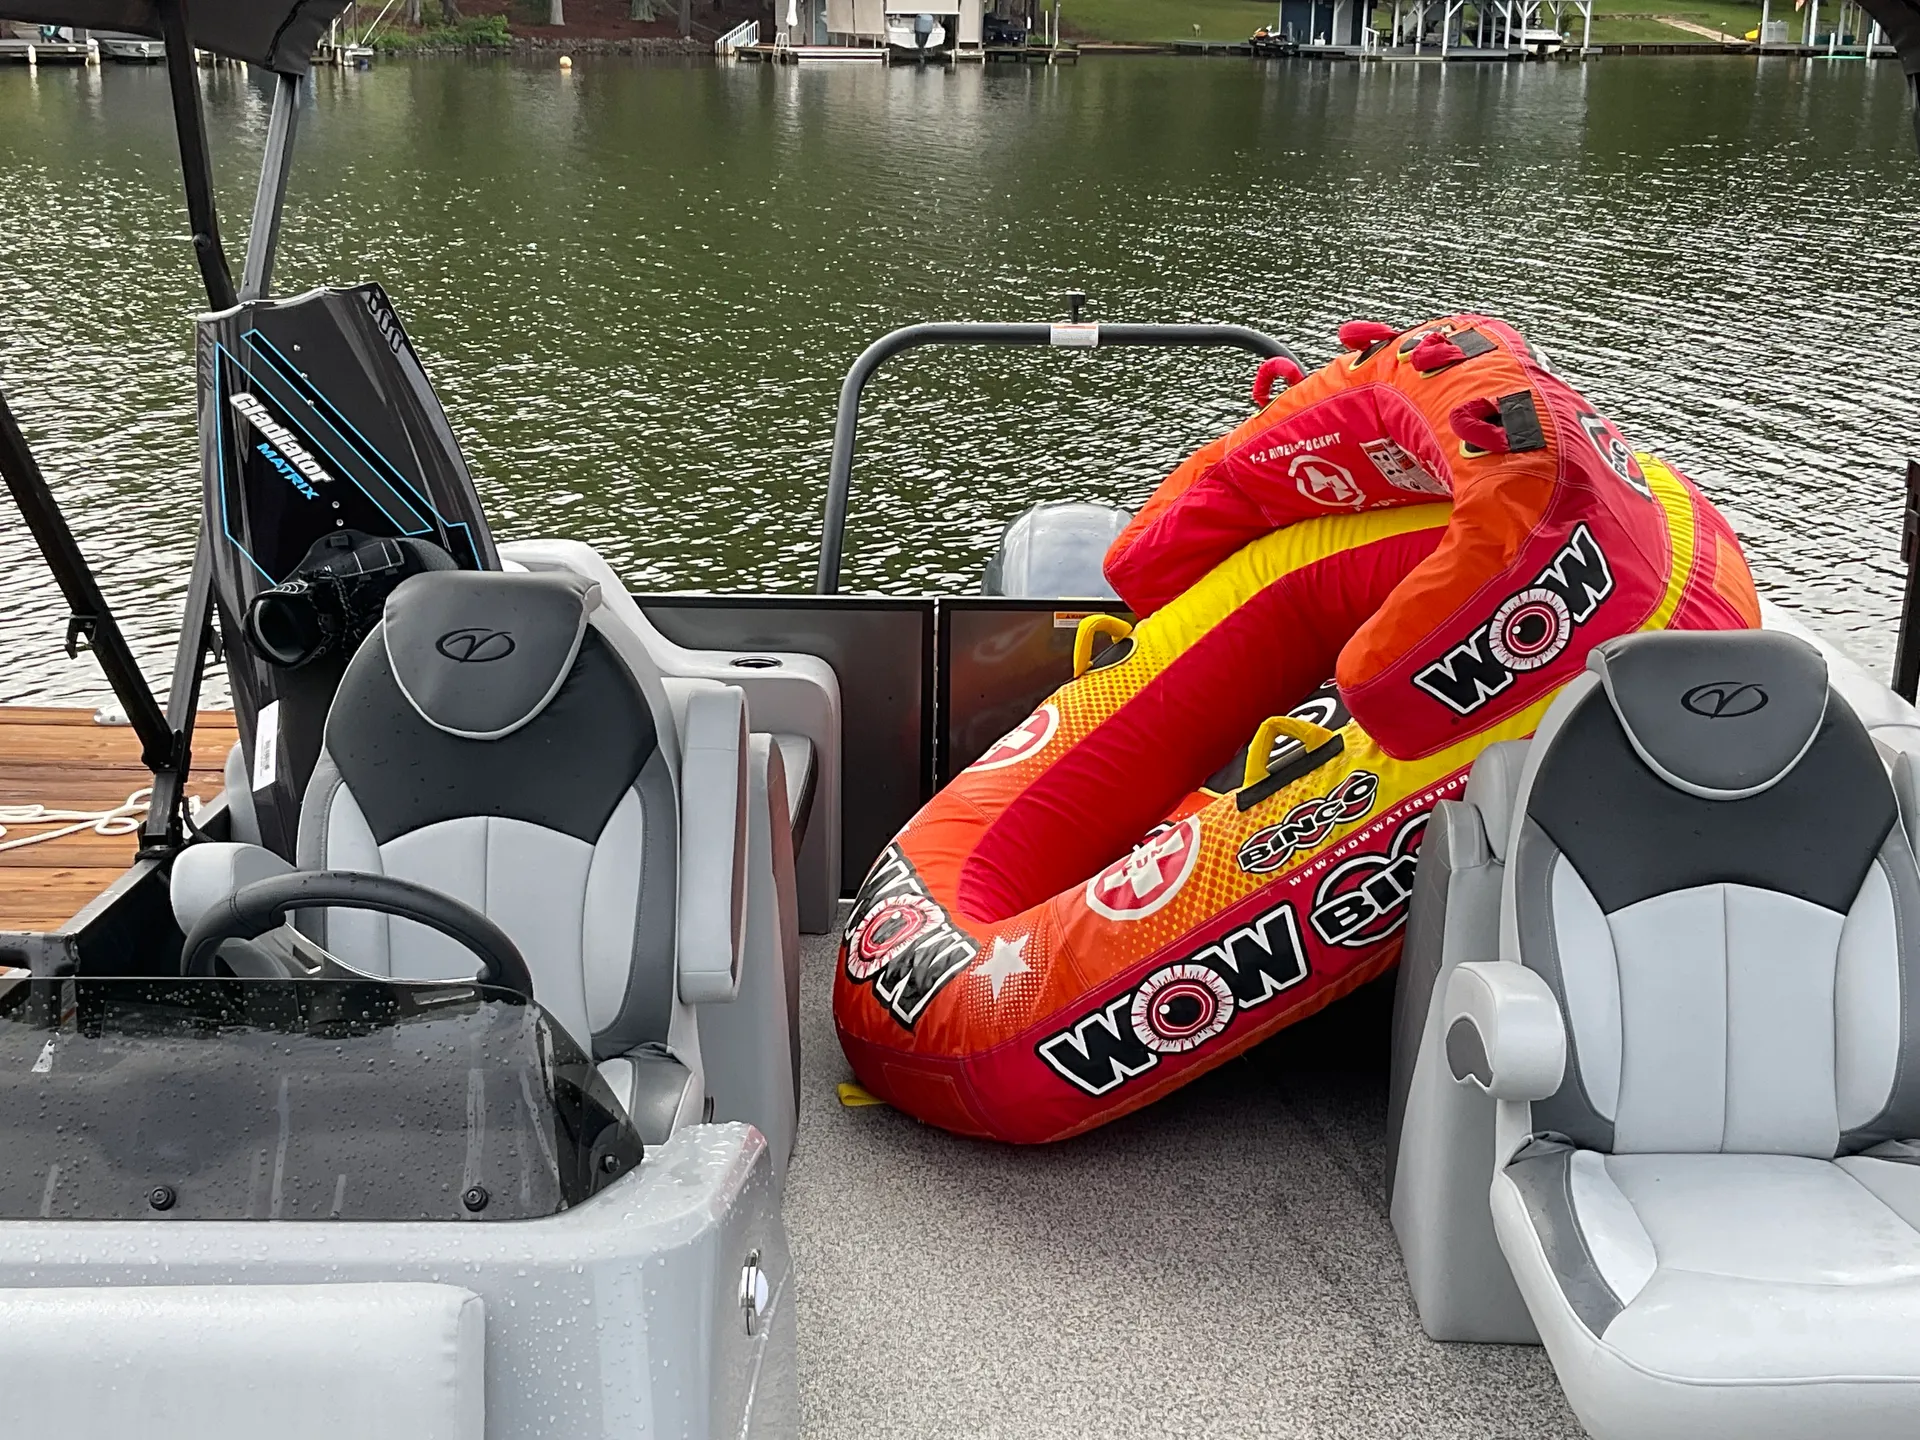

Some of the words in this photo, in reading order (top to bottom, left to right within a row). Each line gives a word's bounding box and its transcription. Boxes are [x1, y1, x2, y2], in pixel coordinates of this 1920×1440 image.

[229, 392, 335, 483] Gladiator
[256, 443, 320, 500] MATRIX
[1410, 521, 1617, 717] WOW
[1238, 769, 1380, 873] BINGO
[844, 842, 979, 1031] WOW
[1035, 901, 1310, 1097] WOW
